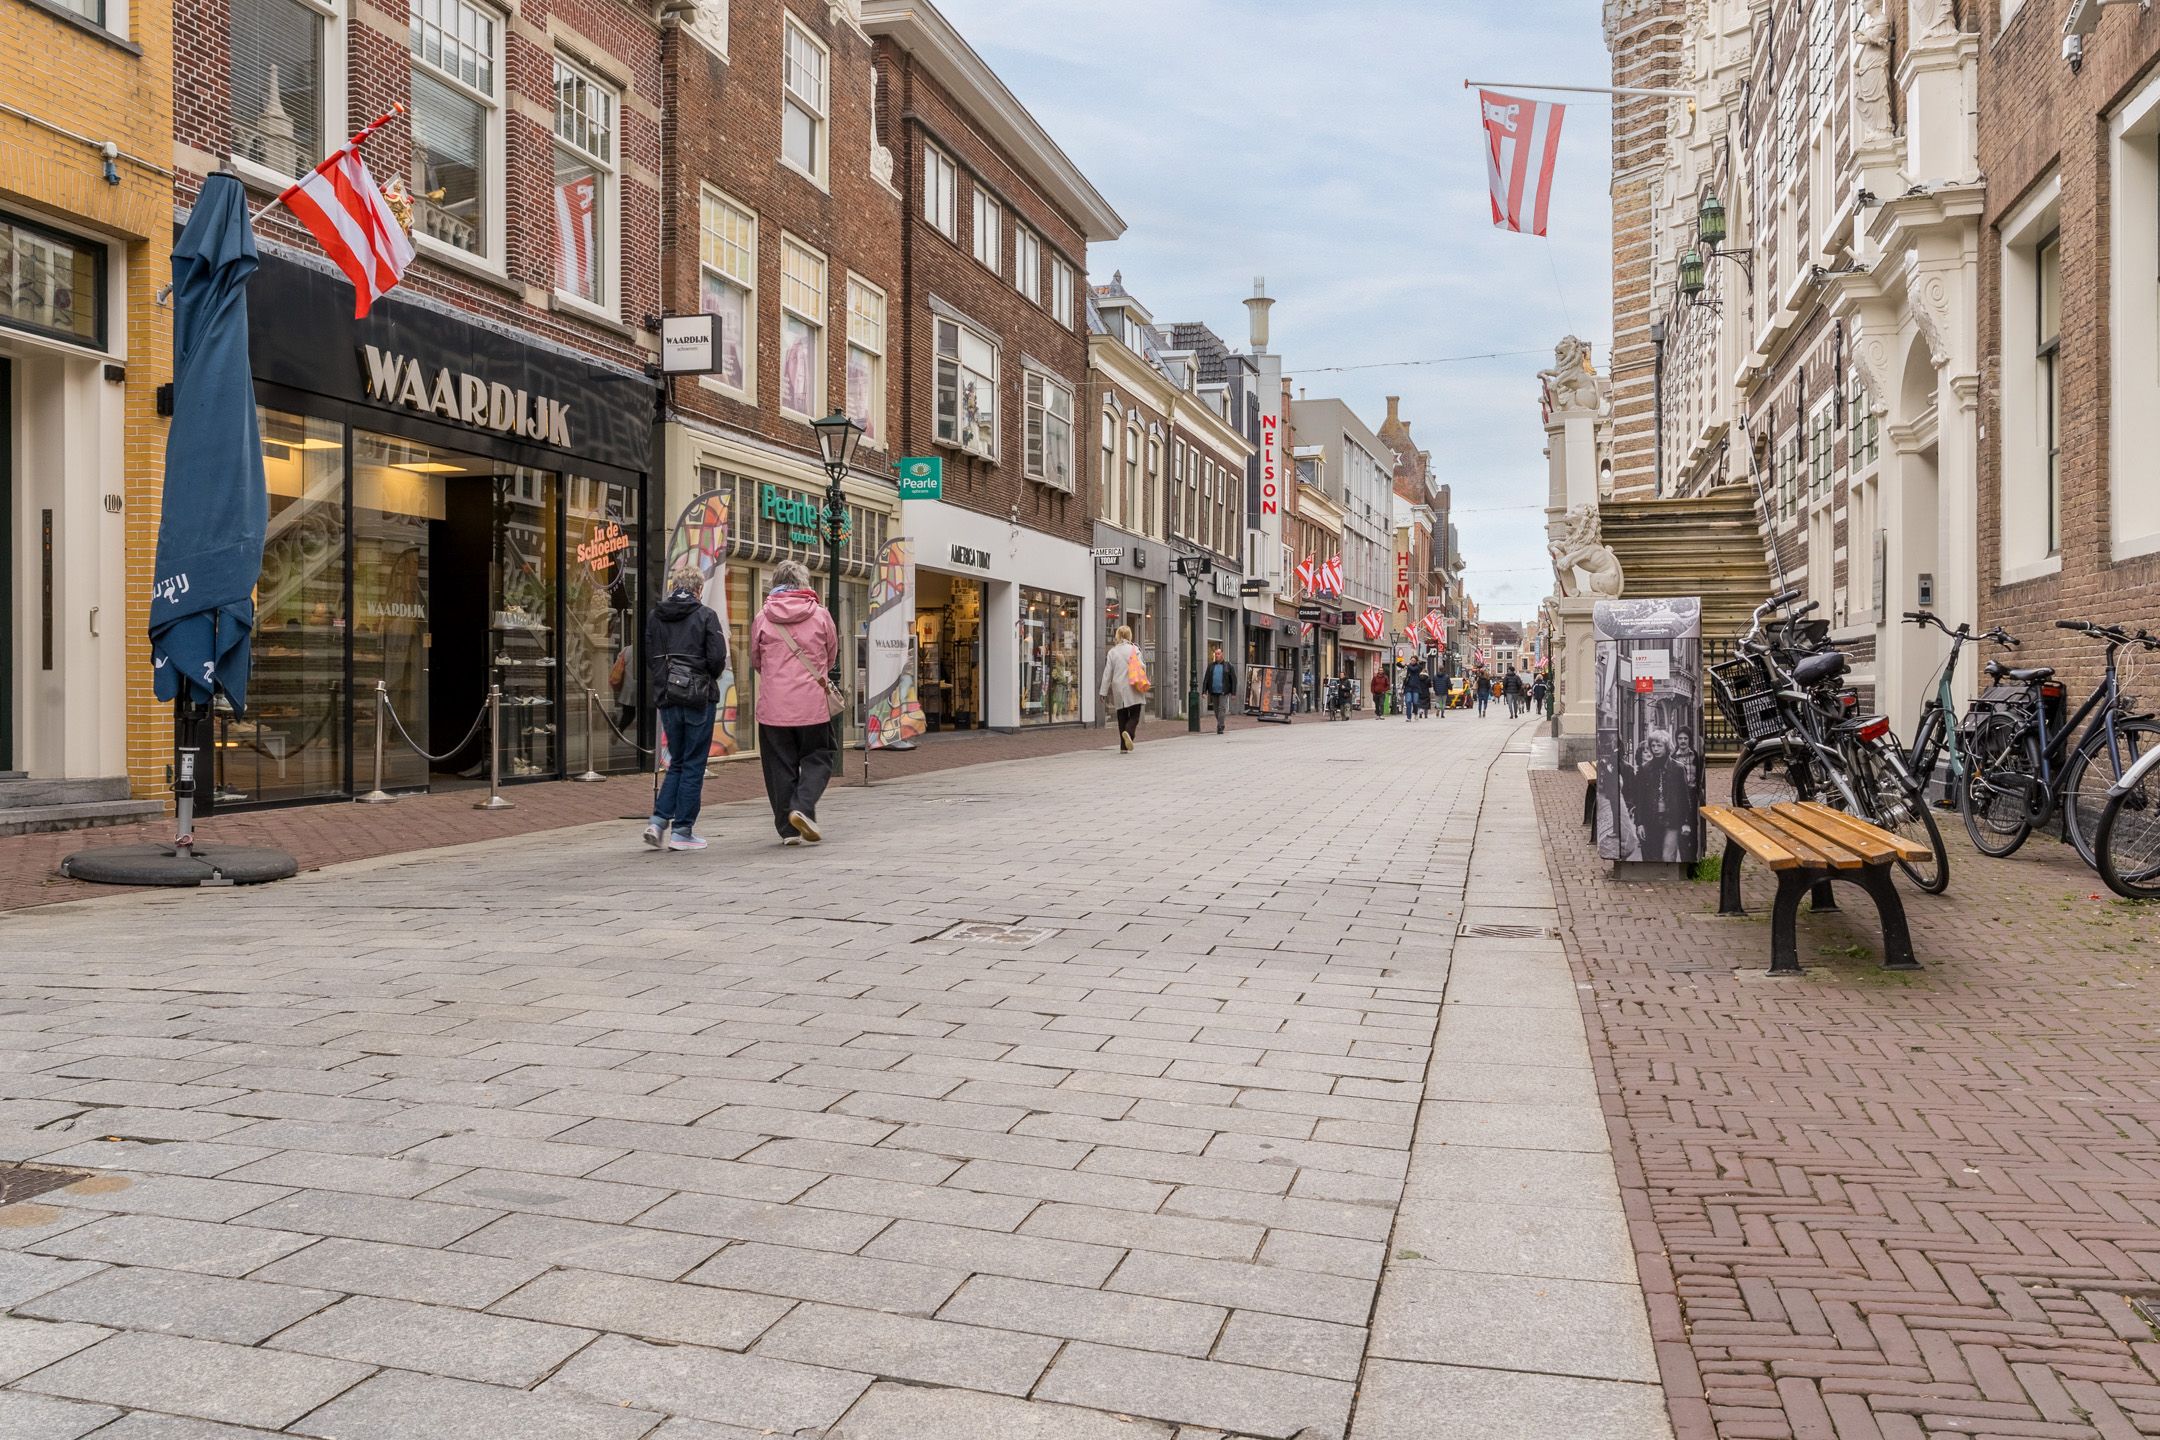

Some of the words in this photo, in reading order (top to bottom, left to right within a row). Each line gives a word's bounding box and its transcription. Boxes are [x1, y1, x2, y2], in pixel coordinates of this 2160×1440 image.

[666, 336, 709, 344] WAARDIJK
[365, 344, 571, 448] WAARDIJK
[1262, 415, 1276, 514] NELSON
[903, 478, 937, 488] Pearle
[107, 494, 121, 511] 100
[762, 484, 817, 530] Pearle
[594, 526, 605, 543] In
[606, 521, 618, 539] de
[577, 534, 629, 562] Schoenen
[951, 544, 976, 567] AMERICA
[1095, 548, 1123, 556] AMERICA
[1100, 557, 1118, 565] TODAY
[1397, 552, 1409, 613] HEMA
[366, 601, 425, 619] WAARDIJK
[1427, 648, 1437, 656] JD
